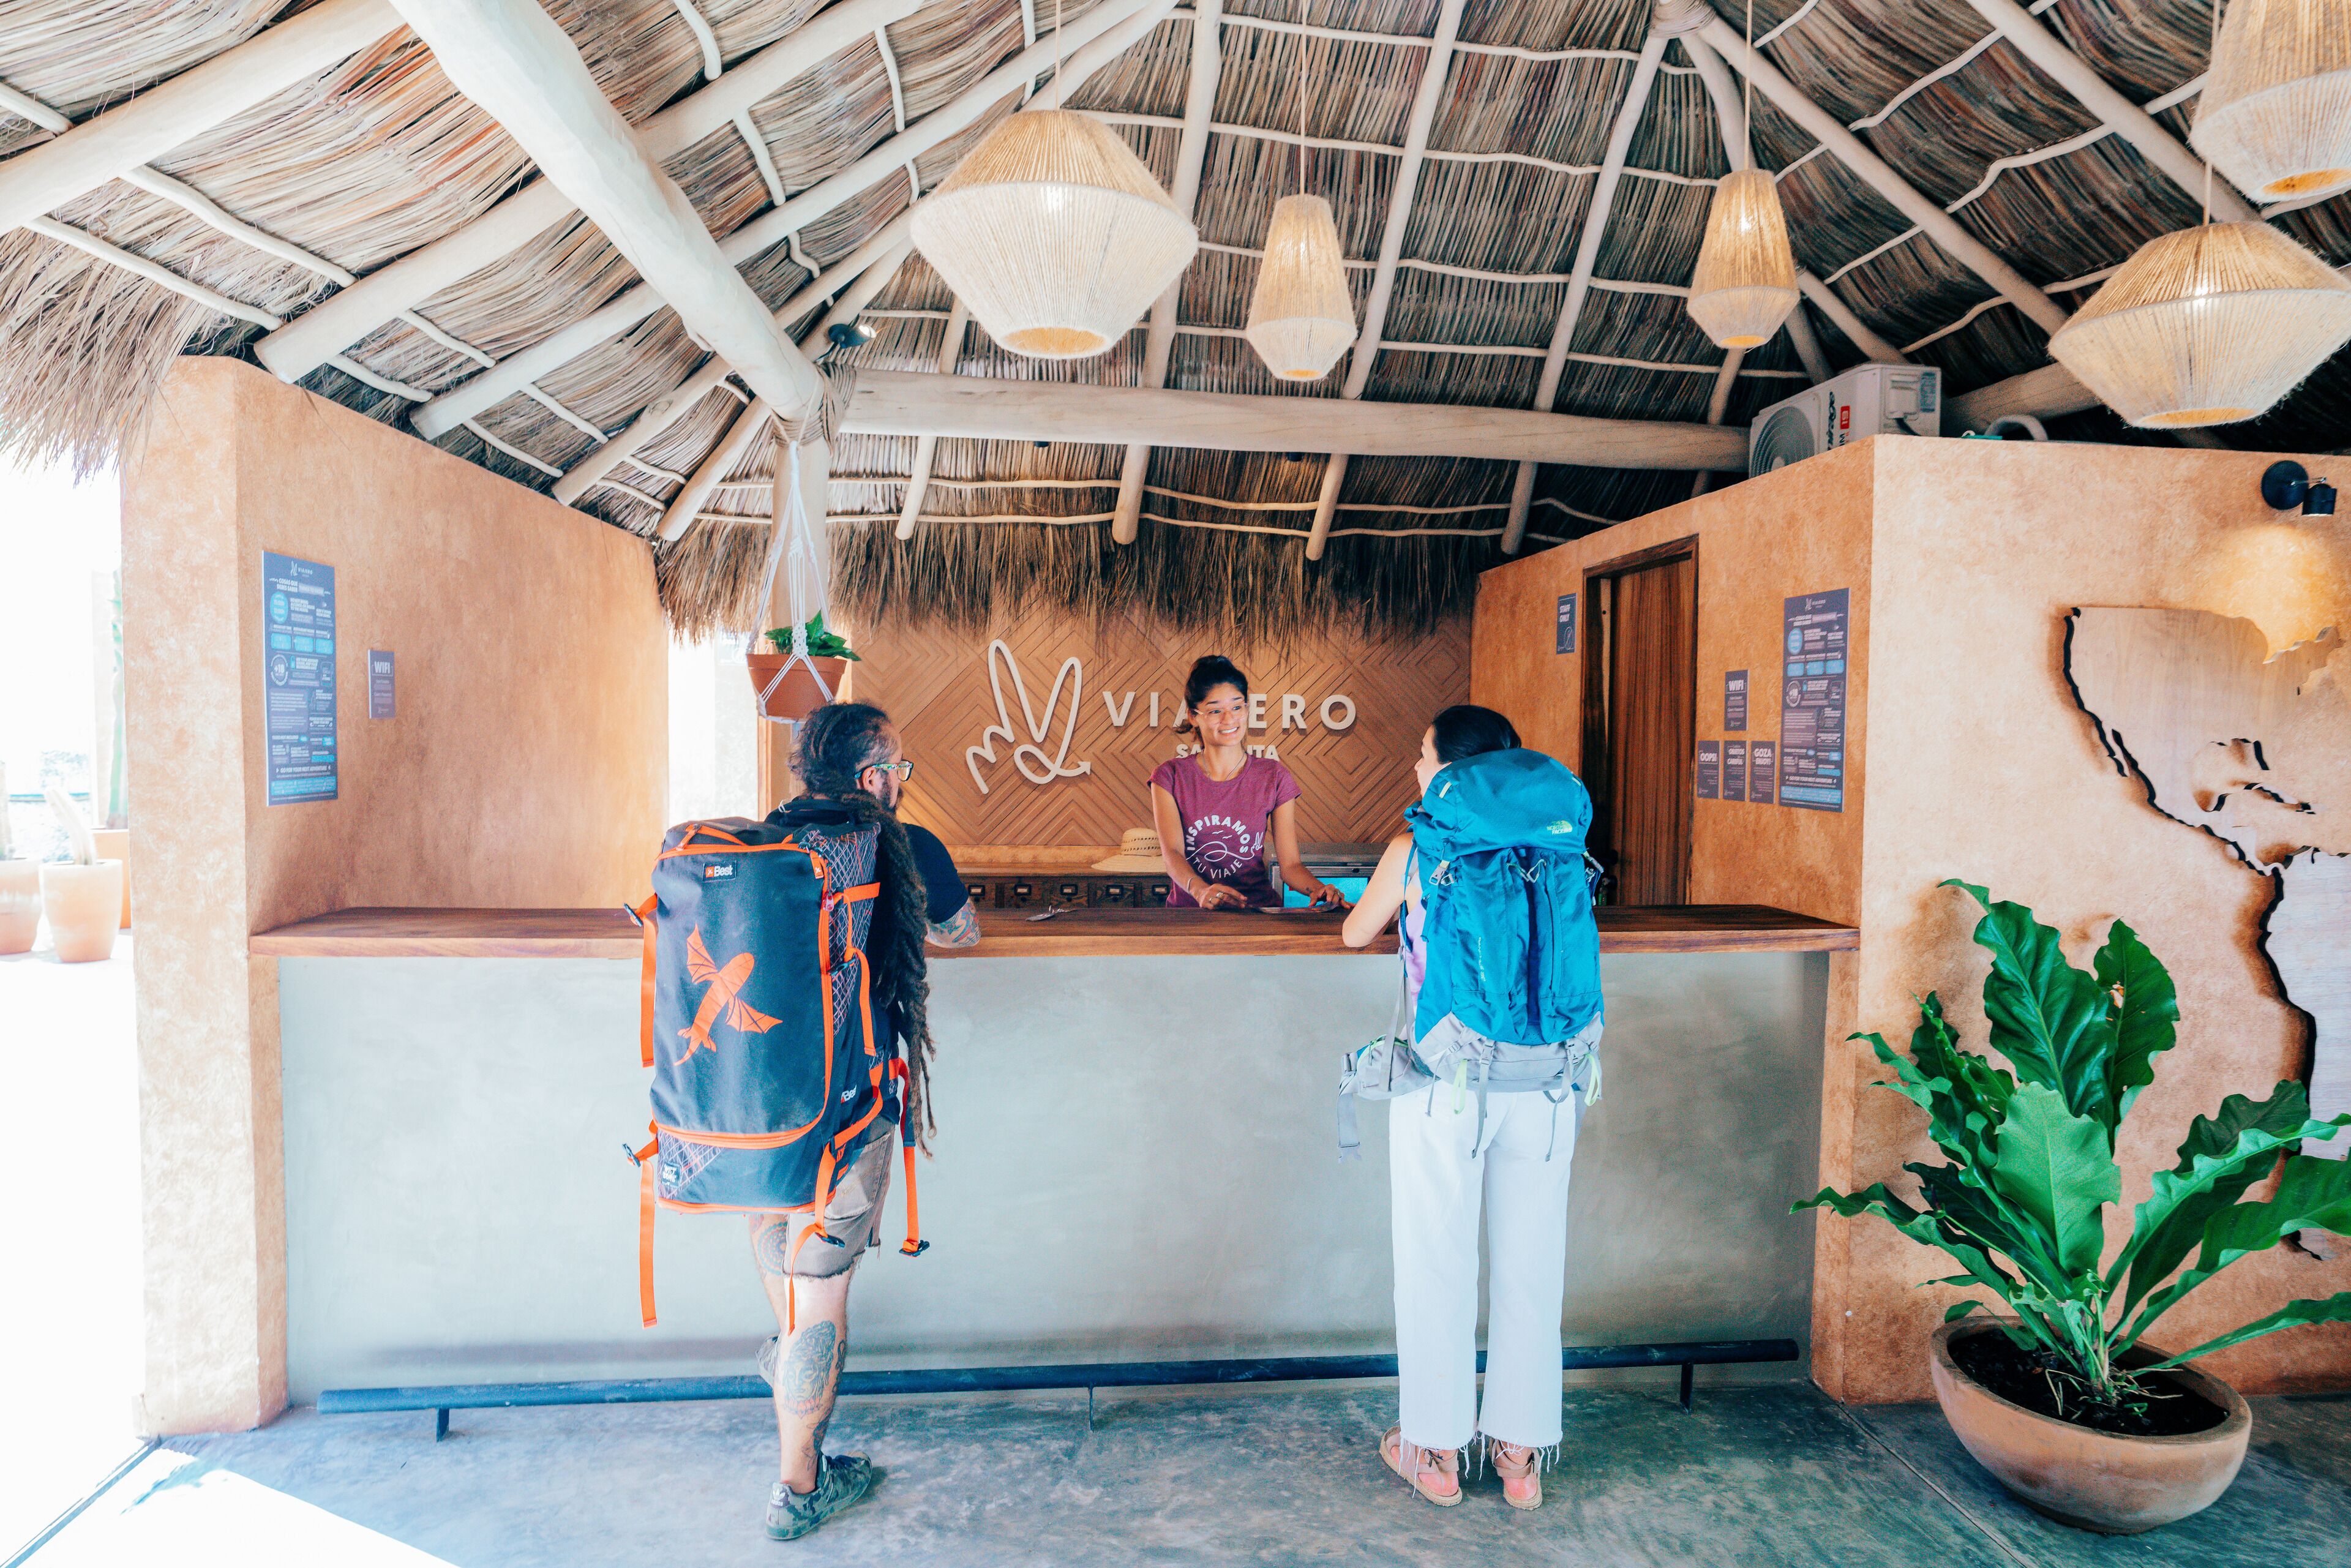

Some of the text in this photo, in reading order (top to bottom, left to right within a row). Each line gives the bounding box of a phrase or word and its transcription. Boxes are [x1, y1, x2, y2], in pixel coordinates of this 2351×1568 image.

[374, 661, 391, 673] WIFI
[1728, 680, 1744, 691] WIFI
[1103, 691, 1357, 731] VIERO
[1754, 748, 1772, 758] GOZA
[1186, 815, 1250, 853] INSPIRAMOS
[1193, 857, 1243, 879] TU VIAJE
